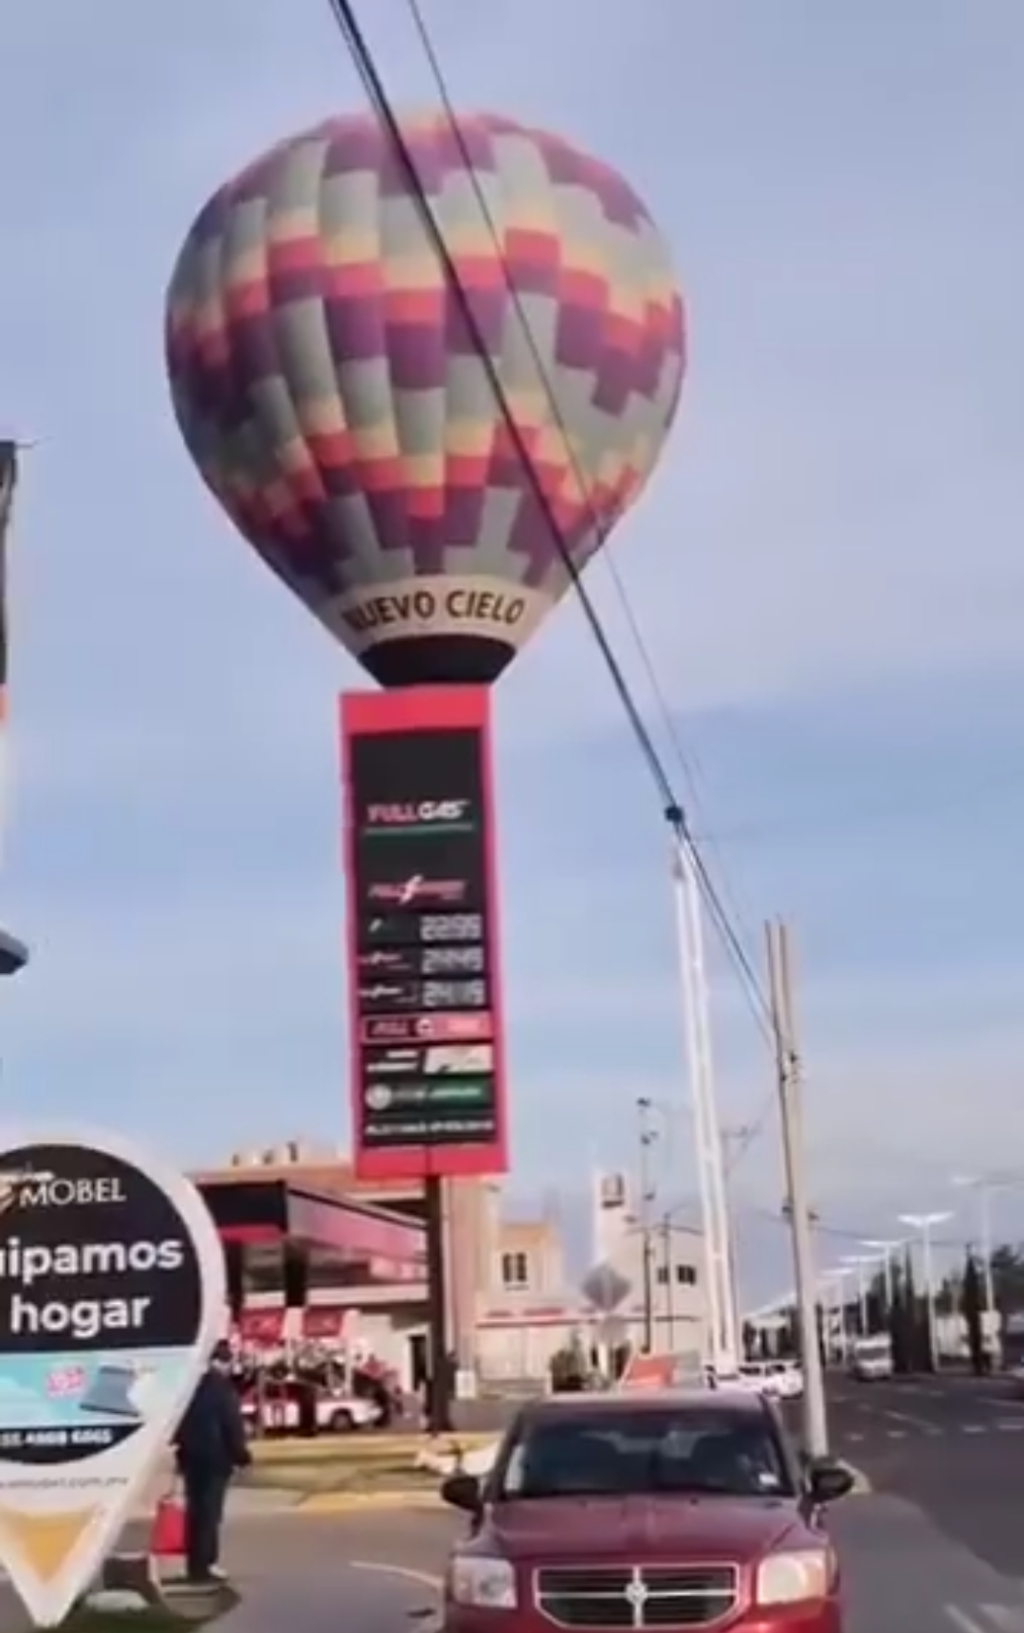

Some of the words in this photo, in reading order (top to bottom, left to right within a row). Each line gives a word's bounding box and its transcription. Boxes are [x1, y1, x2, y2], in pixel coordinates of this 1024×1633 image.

[341, 591, 436, 633] NUEVO
[445, 589, 525, 625] CIELO
[19, 1177, 127, 1208] MOBEL
[10, 1294, 152, 1339] hogar
